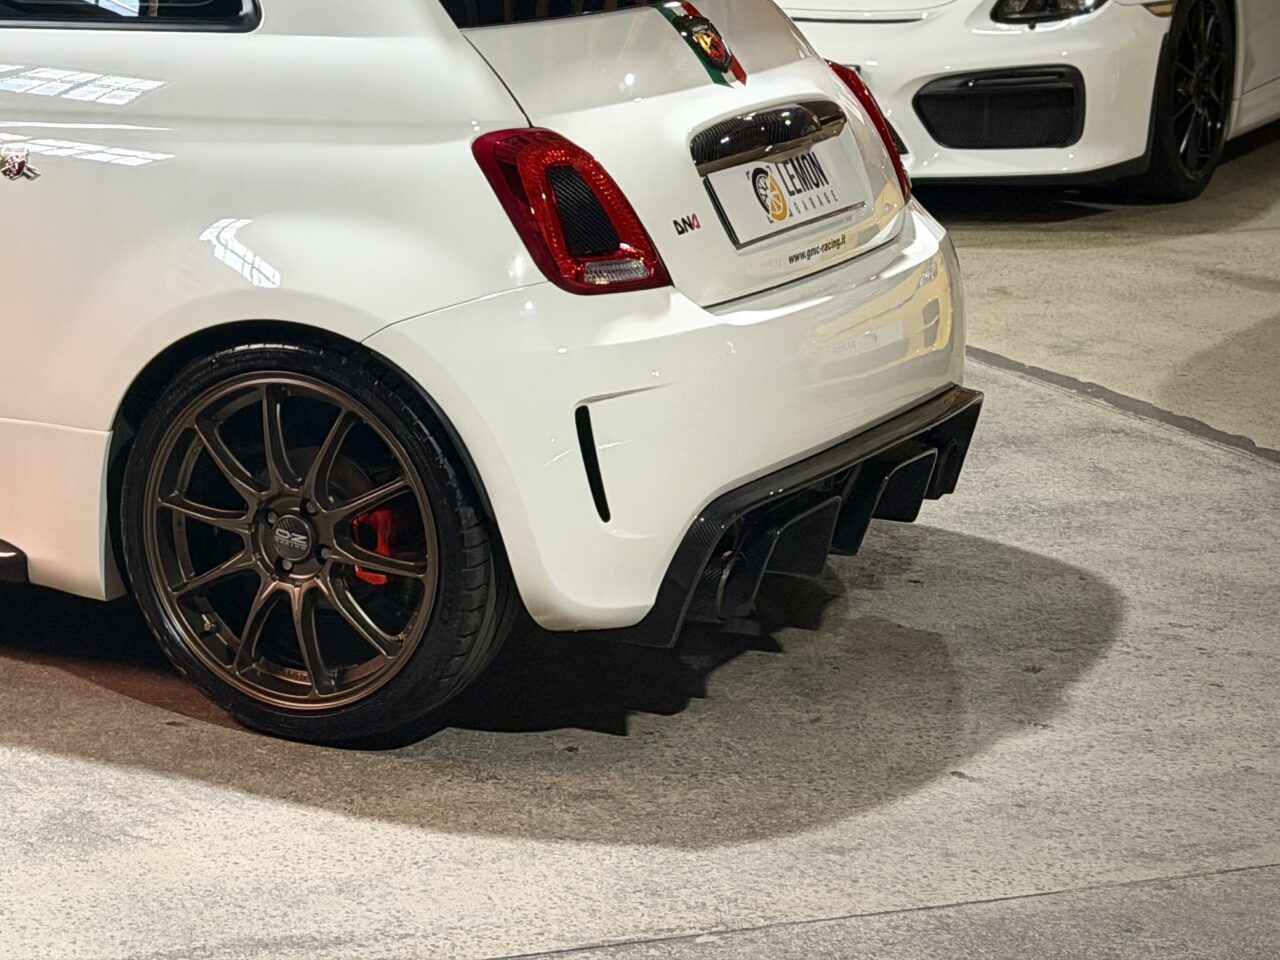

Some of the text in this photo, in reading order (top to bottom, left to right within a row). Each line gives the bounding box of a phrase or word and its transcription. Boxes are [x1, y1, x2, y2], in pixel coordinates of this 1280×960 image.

[774, 151, 830, 197] LEMON
[793, 189, 838, 215] GARAGE
[787, 233, 847, 265] www.gmc-racing.it
